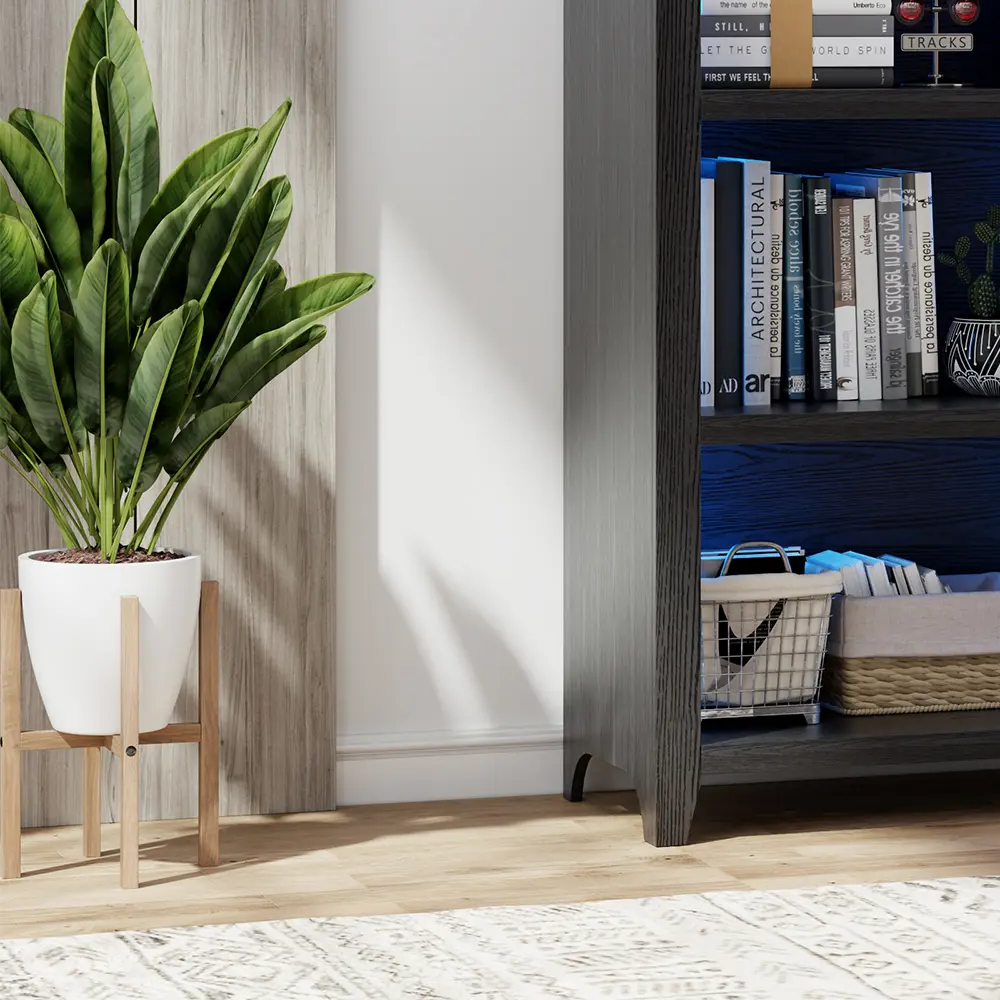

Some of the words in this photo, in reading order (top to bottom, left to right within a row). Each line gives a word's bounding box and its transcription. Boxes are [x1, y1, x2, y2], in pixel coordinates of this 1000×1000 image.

[720, 1, 730, 9] the
[752, 1, 758, 9] of
[759, 1, 769, 9] the
[715, 22, 749, 32] STILL,
[908, 36, 966, 49] TRACKS
[729, 45, 751, 55] THE
[858, 46, 887, 55] SPIN
[704, 73, 727, 82] FIRST
[729, 73, 741, 82] WE
[743, 73, 761, 82] FEEL
[751, 176, 765, 341] ARCHITECTURAL
[719, 377, 738, 394] AD
[745, 373, 770, 393] ar
